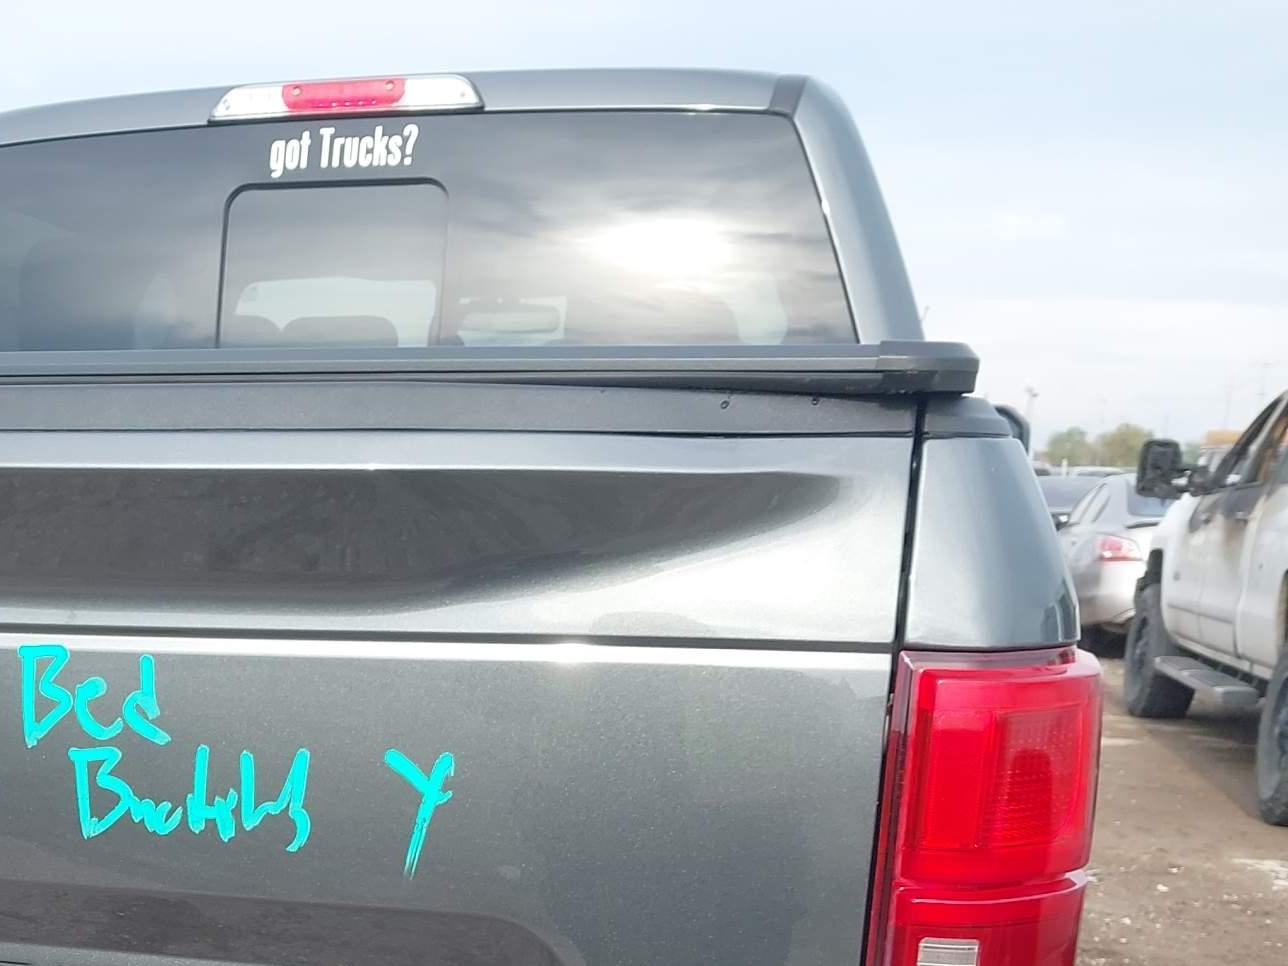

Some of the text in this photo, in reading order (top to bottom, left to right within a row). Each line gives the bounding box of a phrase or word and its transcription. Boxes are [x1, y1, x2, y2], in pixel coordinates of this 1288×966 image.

[270, 124, 419, 178] got Trucks?
[17, 645, 171, 748] Bed
